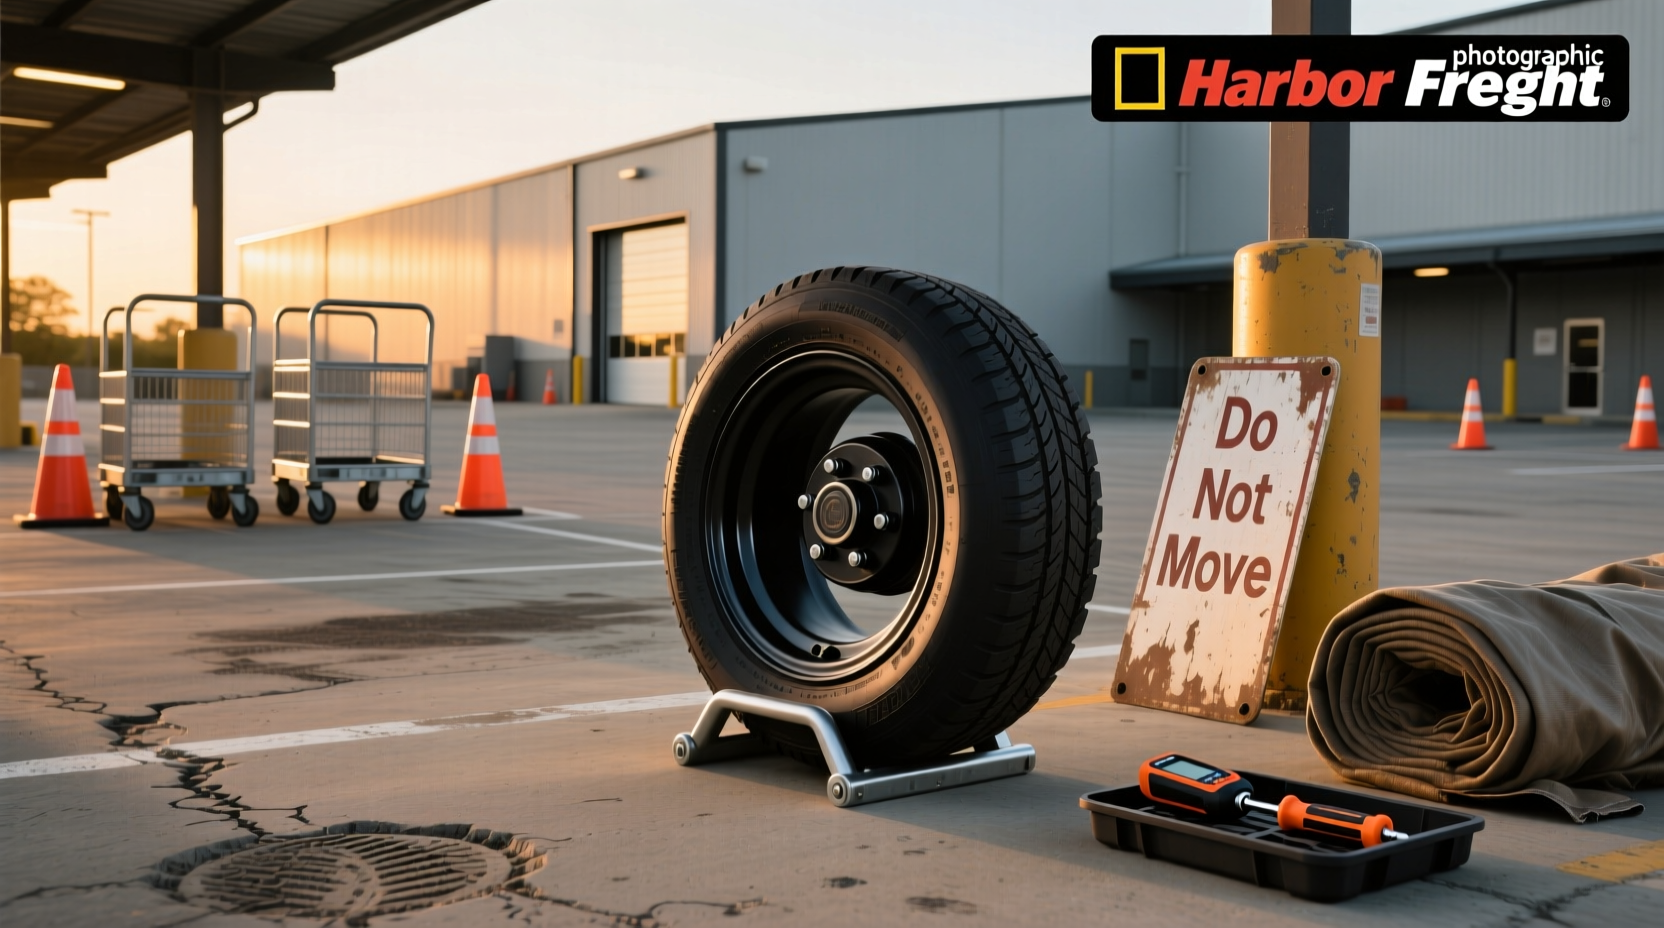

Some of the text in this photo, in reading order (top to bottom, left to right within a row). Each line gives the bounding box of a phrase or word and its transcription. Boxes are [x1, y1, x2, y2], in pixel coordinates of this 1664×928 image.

[1215, 396, 1278, 452] Do
[1192, 467, 1273, 525] Not
[1156, 533, 1272, 599] Move
